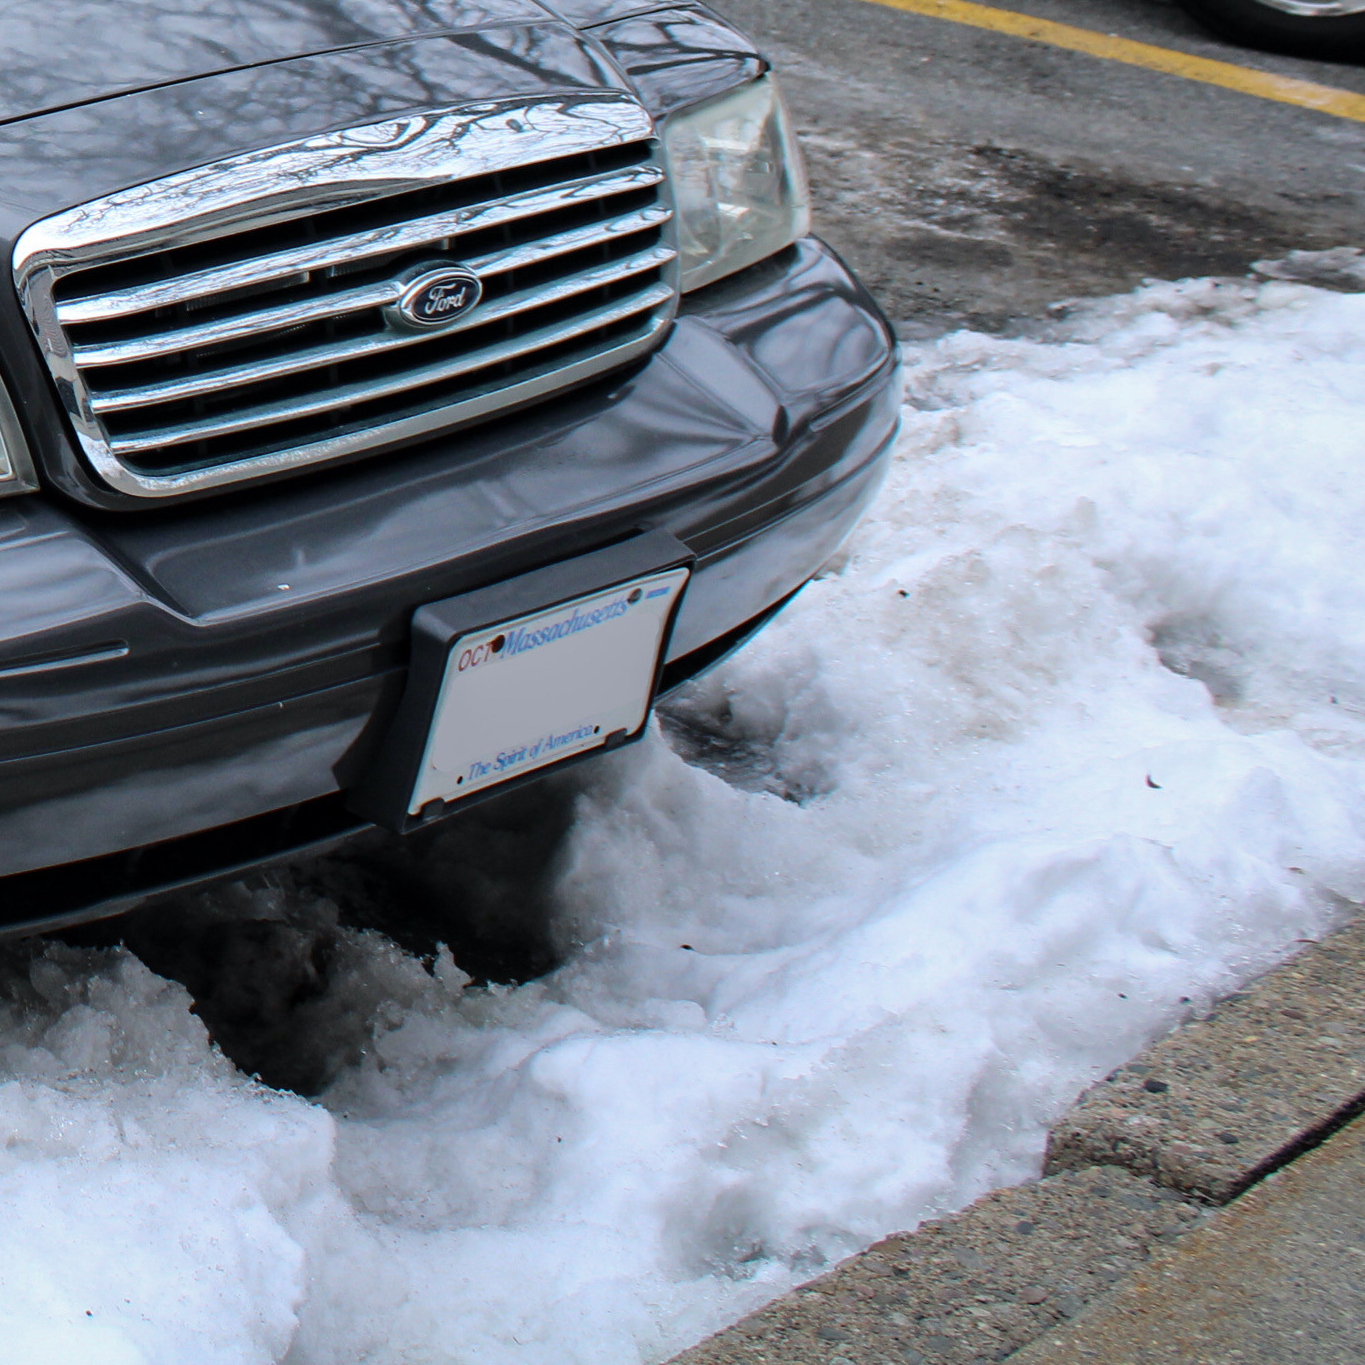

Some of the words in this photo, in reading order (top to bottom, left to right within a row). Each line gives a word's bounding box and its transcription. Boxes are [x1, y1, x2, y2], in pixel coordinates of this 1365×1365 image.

[424, 282, 467, 315] Ford
[458, 640, 495, 672] OCT
[500, 598, 628, 659] Massachusetts
[468, 761, 491, 781] The
[493, 746, 527, 772] Spirit
[529, 738, 544, 759] of
[542, 724, 594, 752] America
